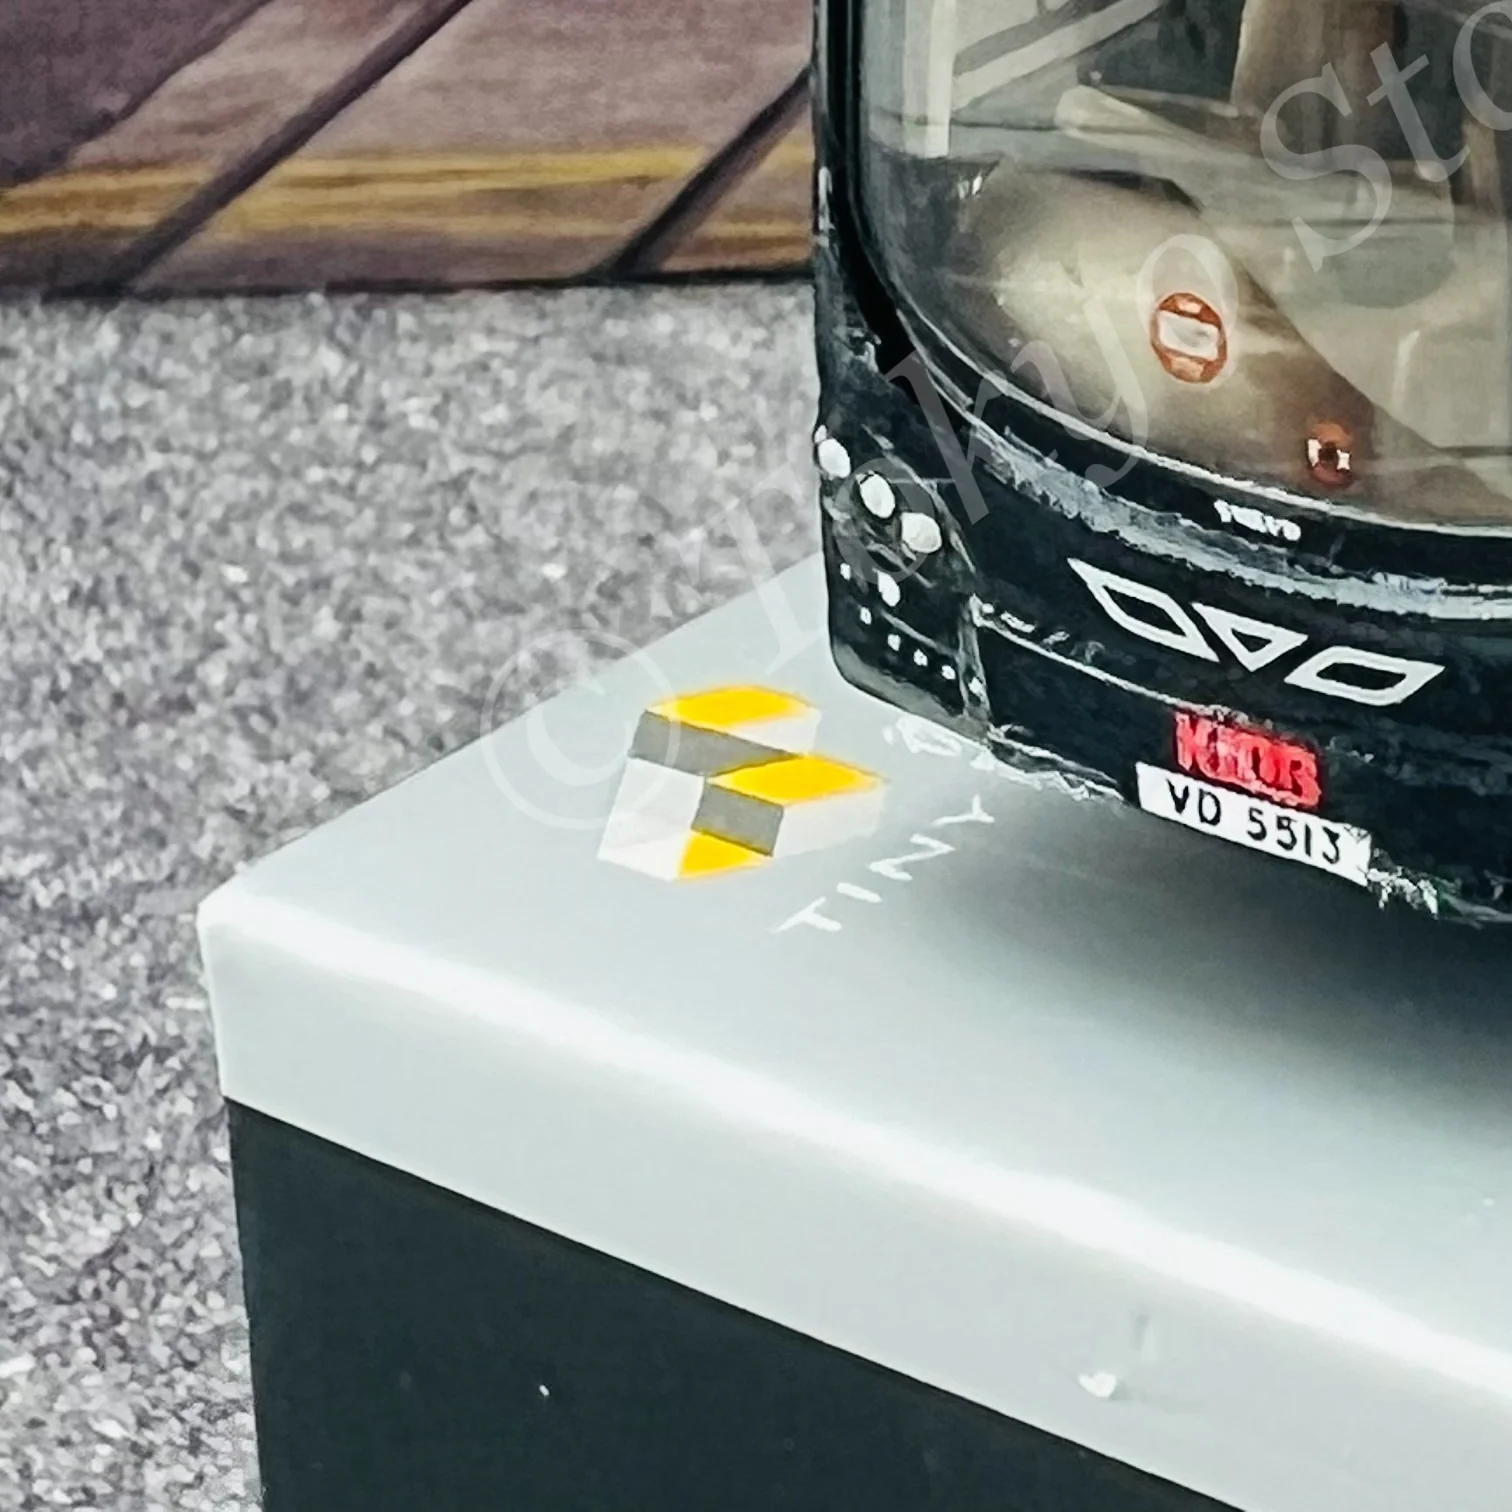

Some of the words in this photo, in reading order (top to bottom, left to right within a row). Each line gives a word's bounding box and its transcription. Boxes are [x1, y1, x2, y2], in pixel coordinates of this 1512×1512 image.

[770, 793, 996, 934] TINY
[1166, 778, 1222, 826] VD
[1246, 805, 1341, 865] 5513
